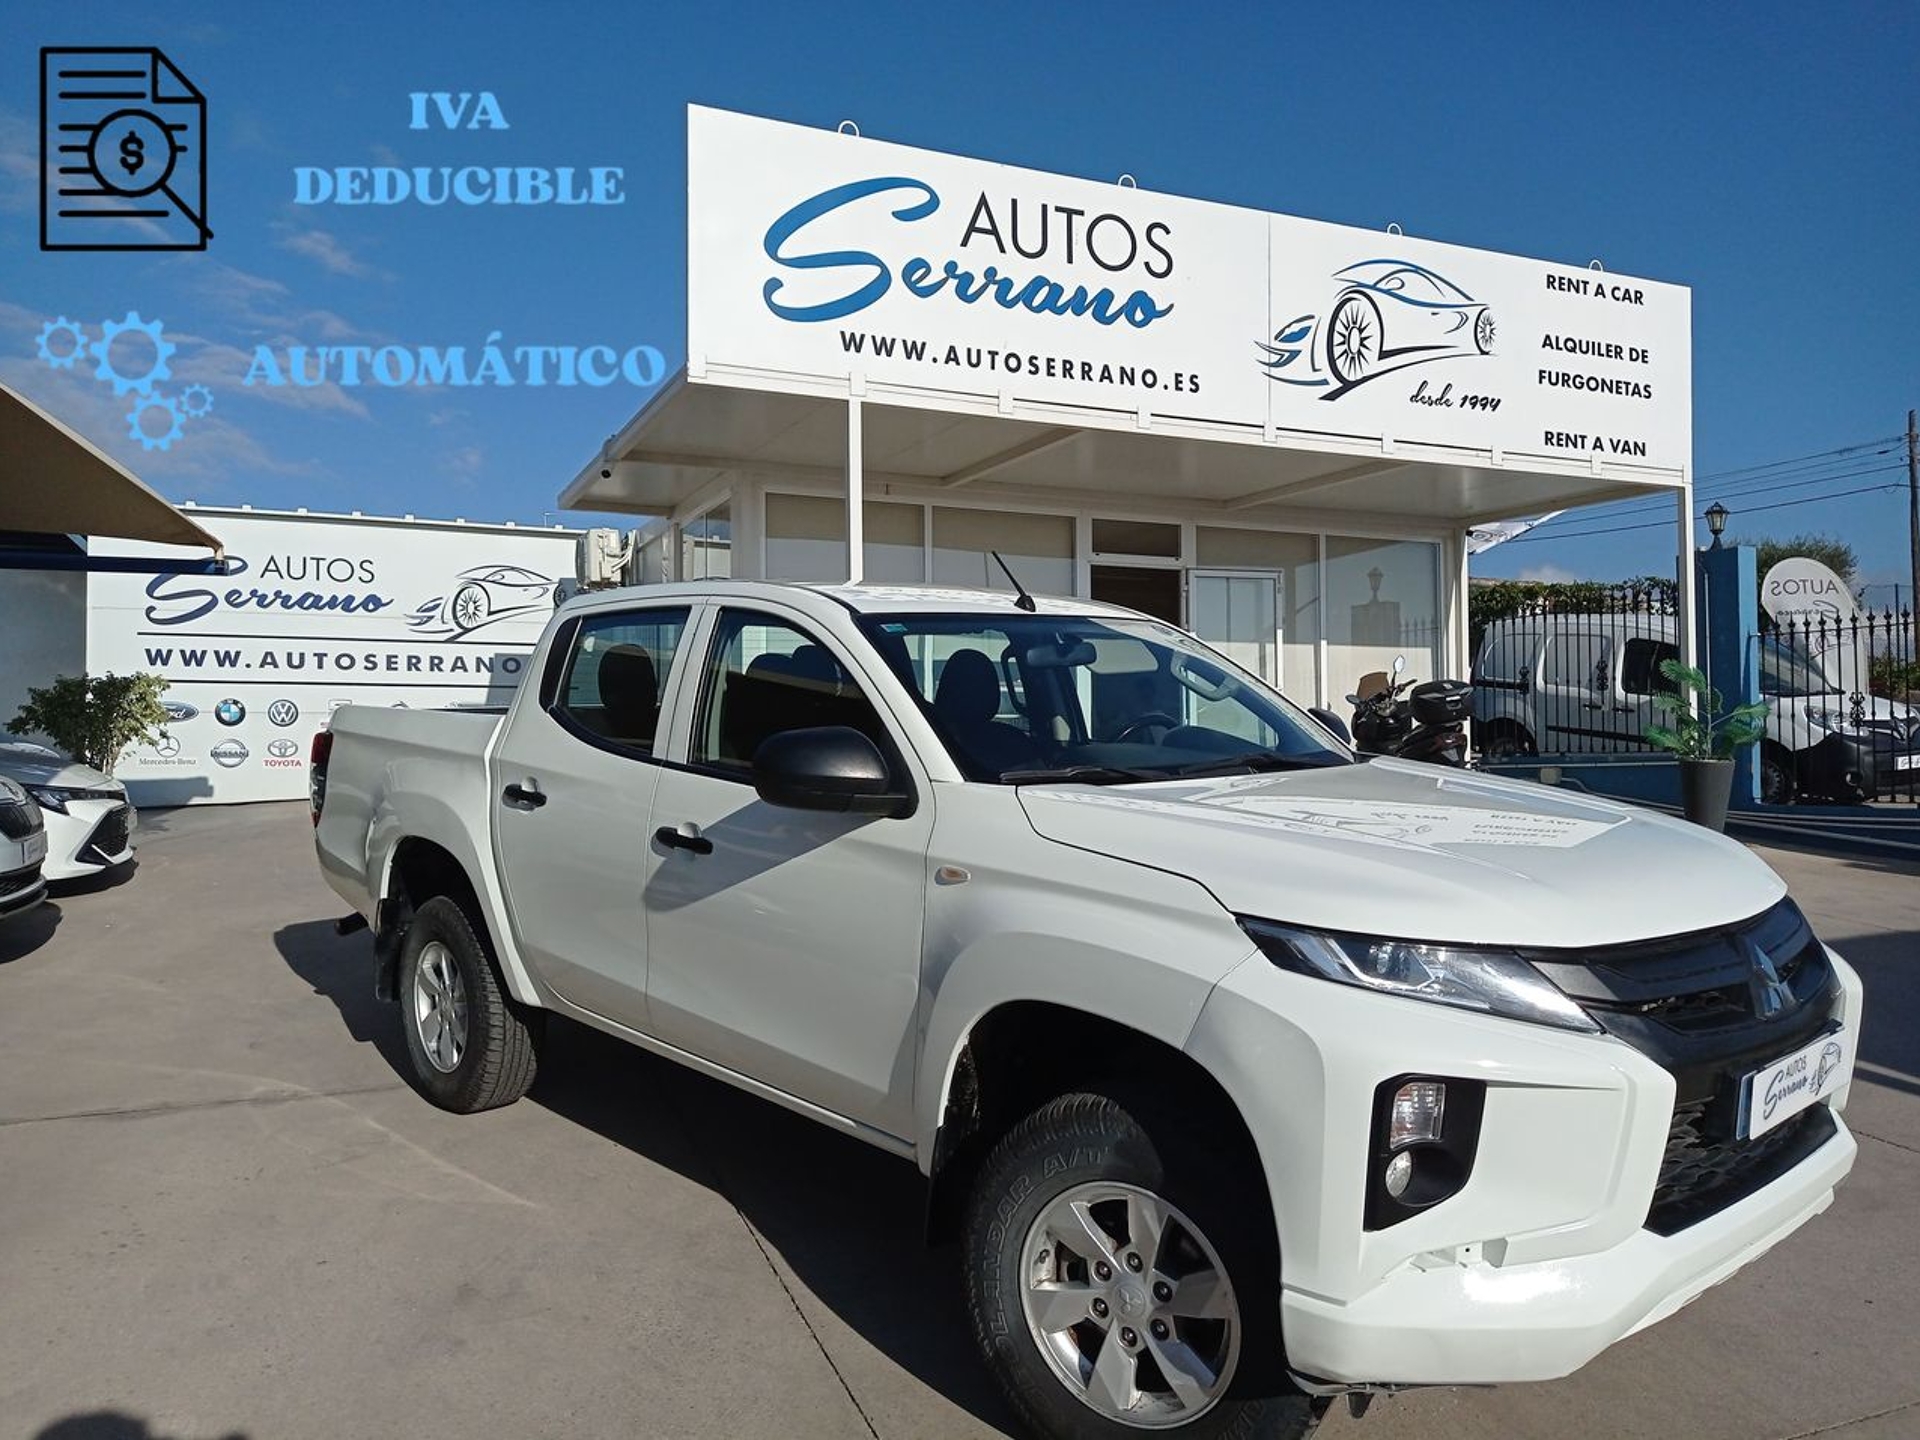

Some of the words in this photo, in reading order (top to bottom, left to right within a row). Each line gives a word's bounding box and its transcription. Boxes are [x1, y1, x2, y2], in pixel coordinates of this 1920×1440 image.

[960, 191, 1174, 280] AUTOS
[763, 177, 1174, 328] Serrano
[1546, 274, 1590, 296] RENT
[1593, 281, 1608, 299] A
[1610, 285, 1645, 306] CAR
[840, 330, 1200, 394] WWW.AUTOSERRANO.ES
[1541, 334, 1624, 361] ALQUILER
[1628, 346, 1650, 364] DE
[1409, 380, 1454, 408] desde
[1459, 394, 1502, 412] 1994
[1538, 370, 1652, 400] FURGONETAS
[1544, 431, 1588, 451] RENT
[1591, 436, 1606, 453] A
[1608, 437, 1647, 457] VAN
[260, 555, 375, 584] AUTOS
[145, 555, 394, 625] Serrano
[263, 758, 302, 768] TOYOTA
